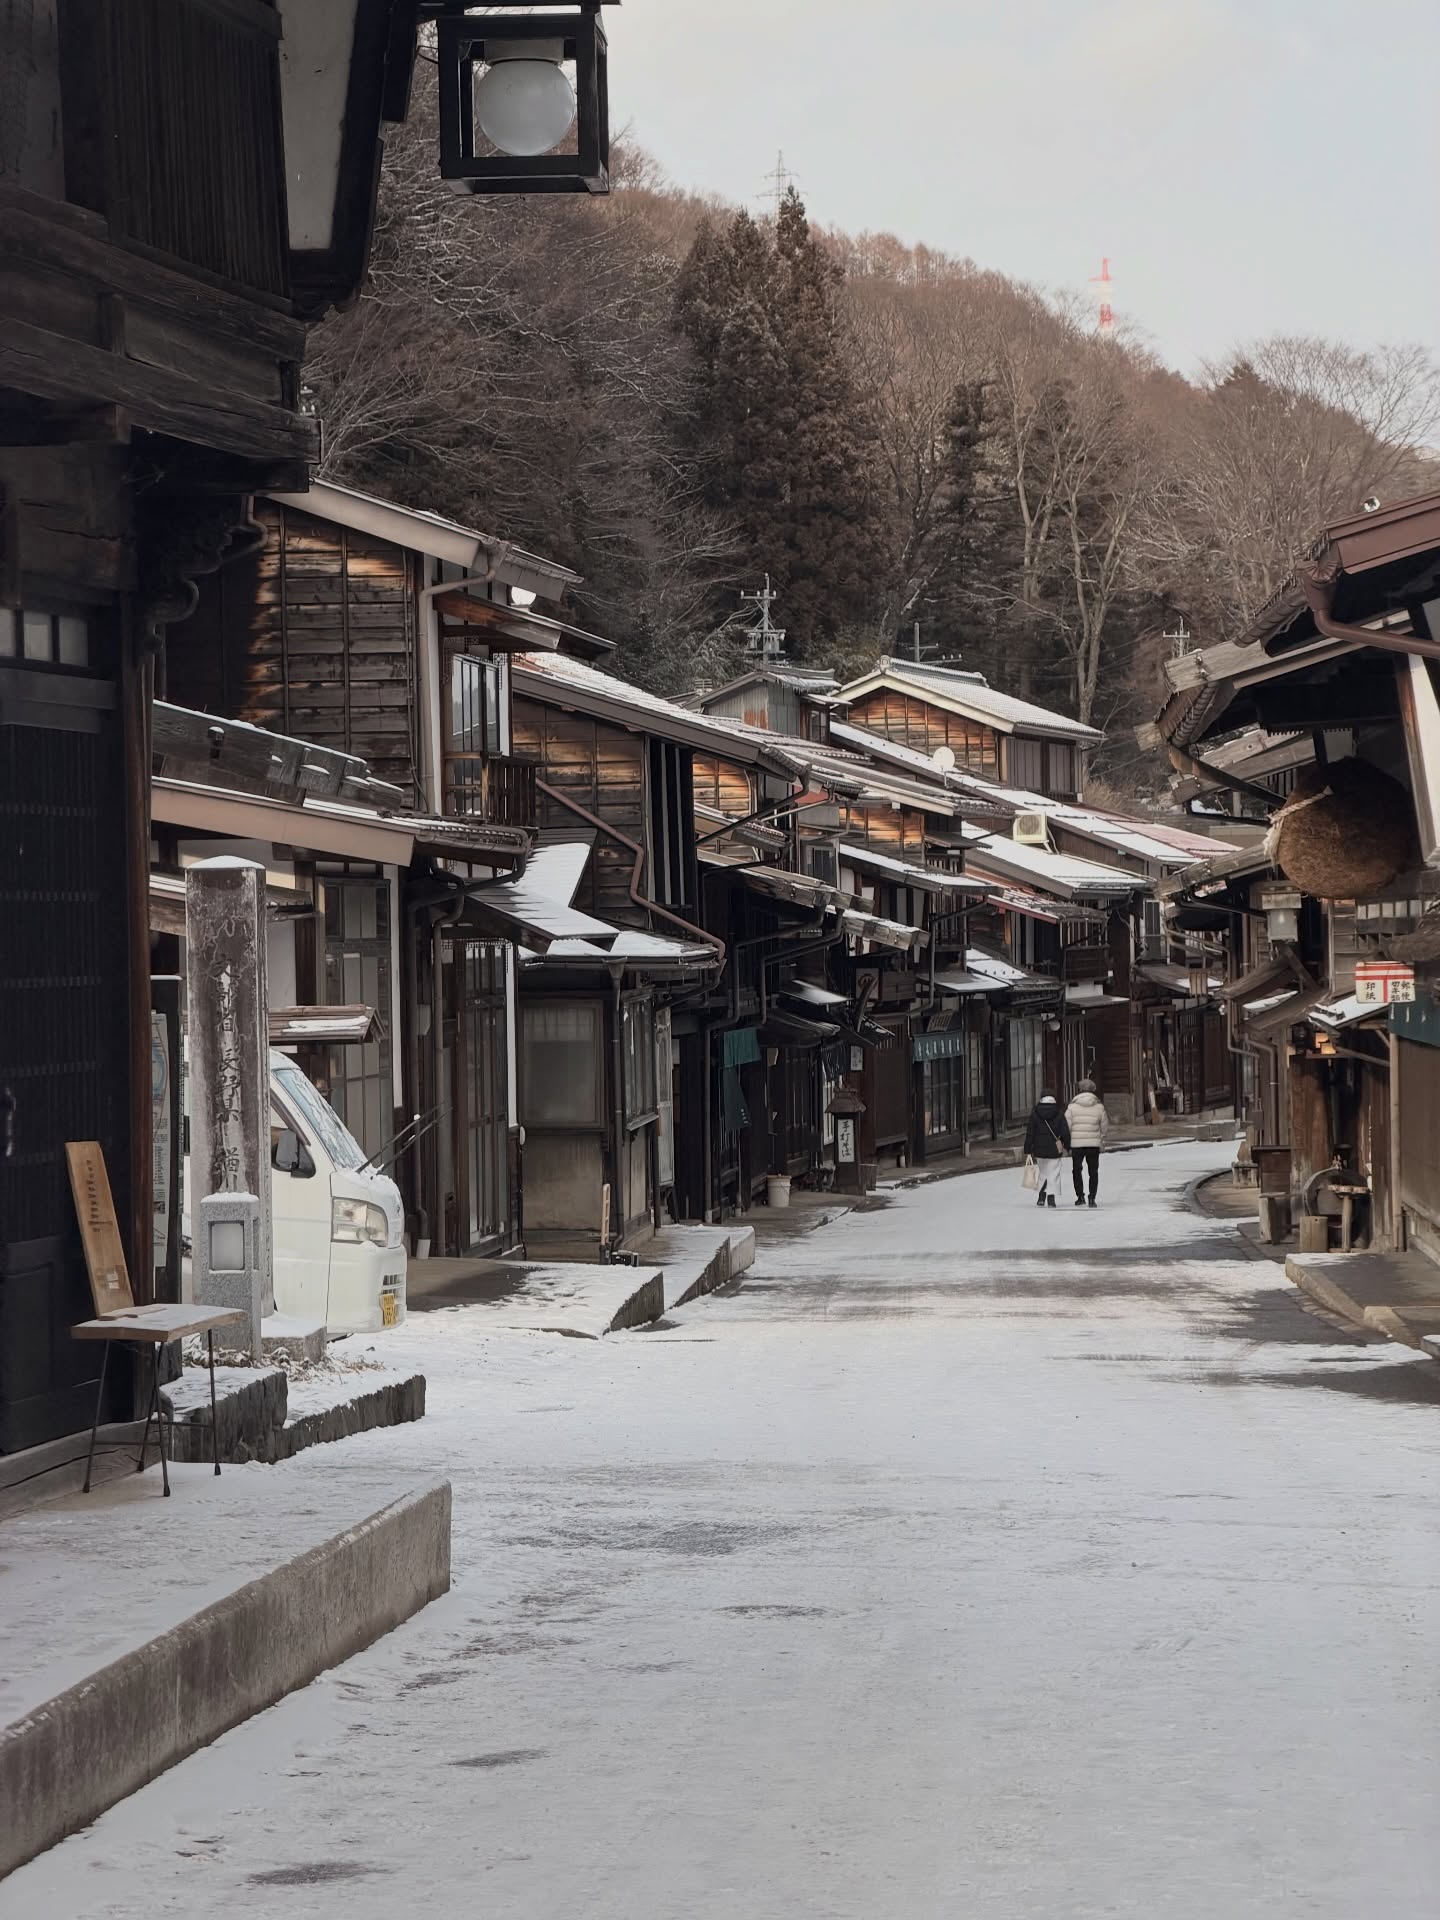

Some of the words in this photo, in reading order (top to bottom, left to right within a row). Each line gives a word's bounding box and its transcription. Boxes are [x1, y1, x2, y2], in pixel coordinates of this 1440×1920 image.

[1366, 982, 1376, 1000] 印紙
[1391, 981, 1400, 1001] 切手類
[1401, 980, 1411, 1001] 郵便
[215, 1048, 244, 1124] 長野県
